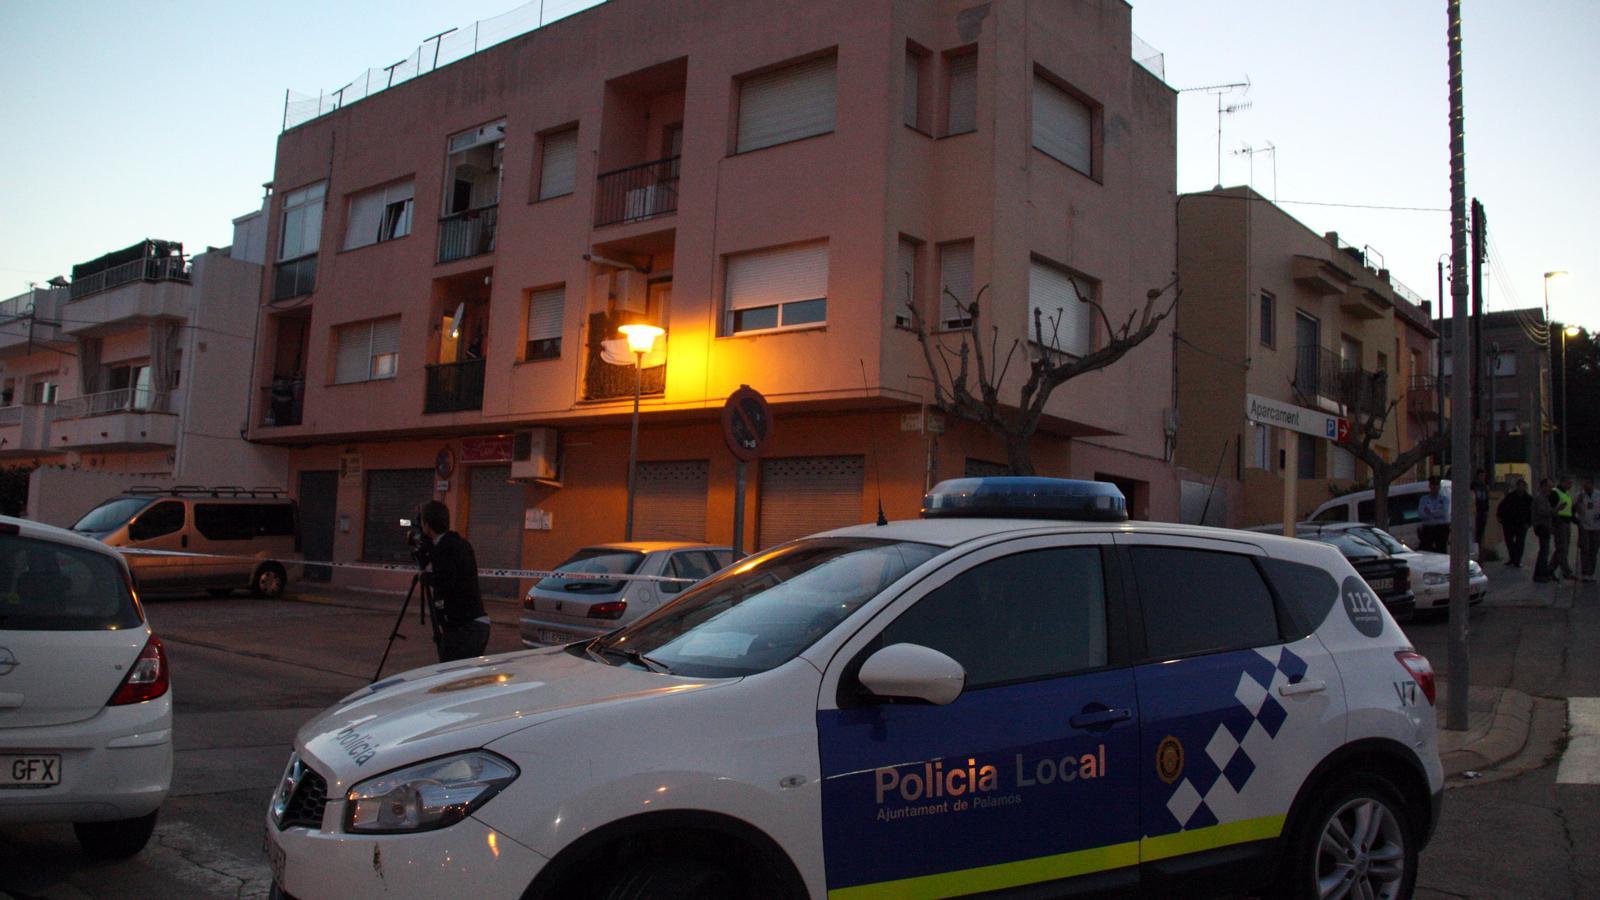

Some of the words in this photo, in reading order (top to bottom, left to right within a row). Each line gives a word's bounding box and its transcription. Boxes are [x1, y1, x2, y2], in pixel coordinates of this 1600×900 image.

[1250, 399, 1300, 425] Aparcament
[1346, 591, 1376, 613] 112
[1393, 680, 1416, 706] V7
[12, 759, 55, 781] GFX
[875, 757, 998, 804] Policia
[1016, 743, 1106, 787] Local
[876, 801, 948, 822] Ajuntament
[953, 799, 968, 812] de
[973, 792, 1022, 808] Palamós
